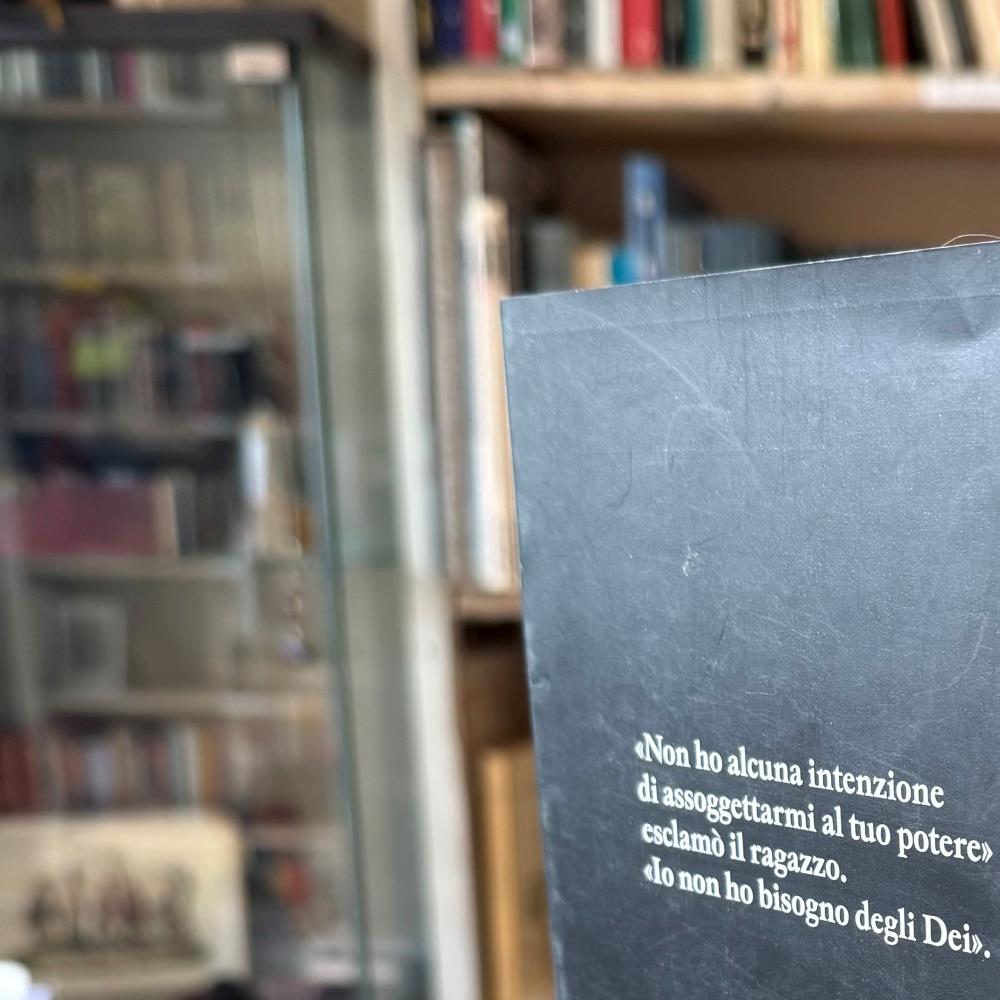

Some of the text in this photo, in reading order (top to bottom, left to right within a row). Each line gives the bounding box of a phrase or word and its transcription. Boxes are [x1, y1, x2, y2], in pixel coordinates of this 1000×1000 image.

[634, 732, 945, 809] «Non ho alcuna intenzione
[637, 773, 994, 864] di assoggettarmi al tuo potere»
[641, 819, 848, 884] esclamò il ragazzo.
[679, 868, 721, 898] non
[725, 870, 754, 905] ho
[757, 878, 850, 927] bisogno
[855, 900, 916, 946] degli
[922, 913, 992, 959] Dei».
